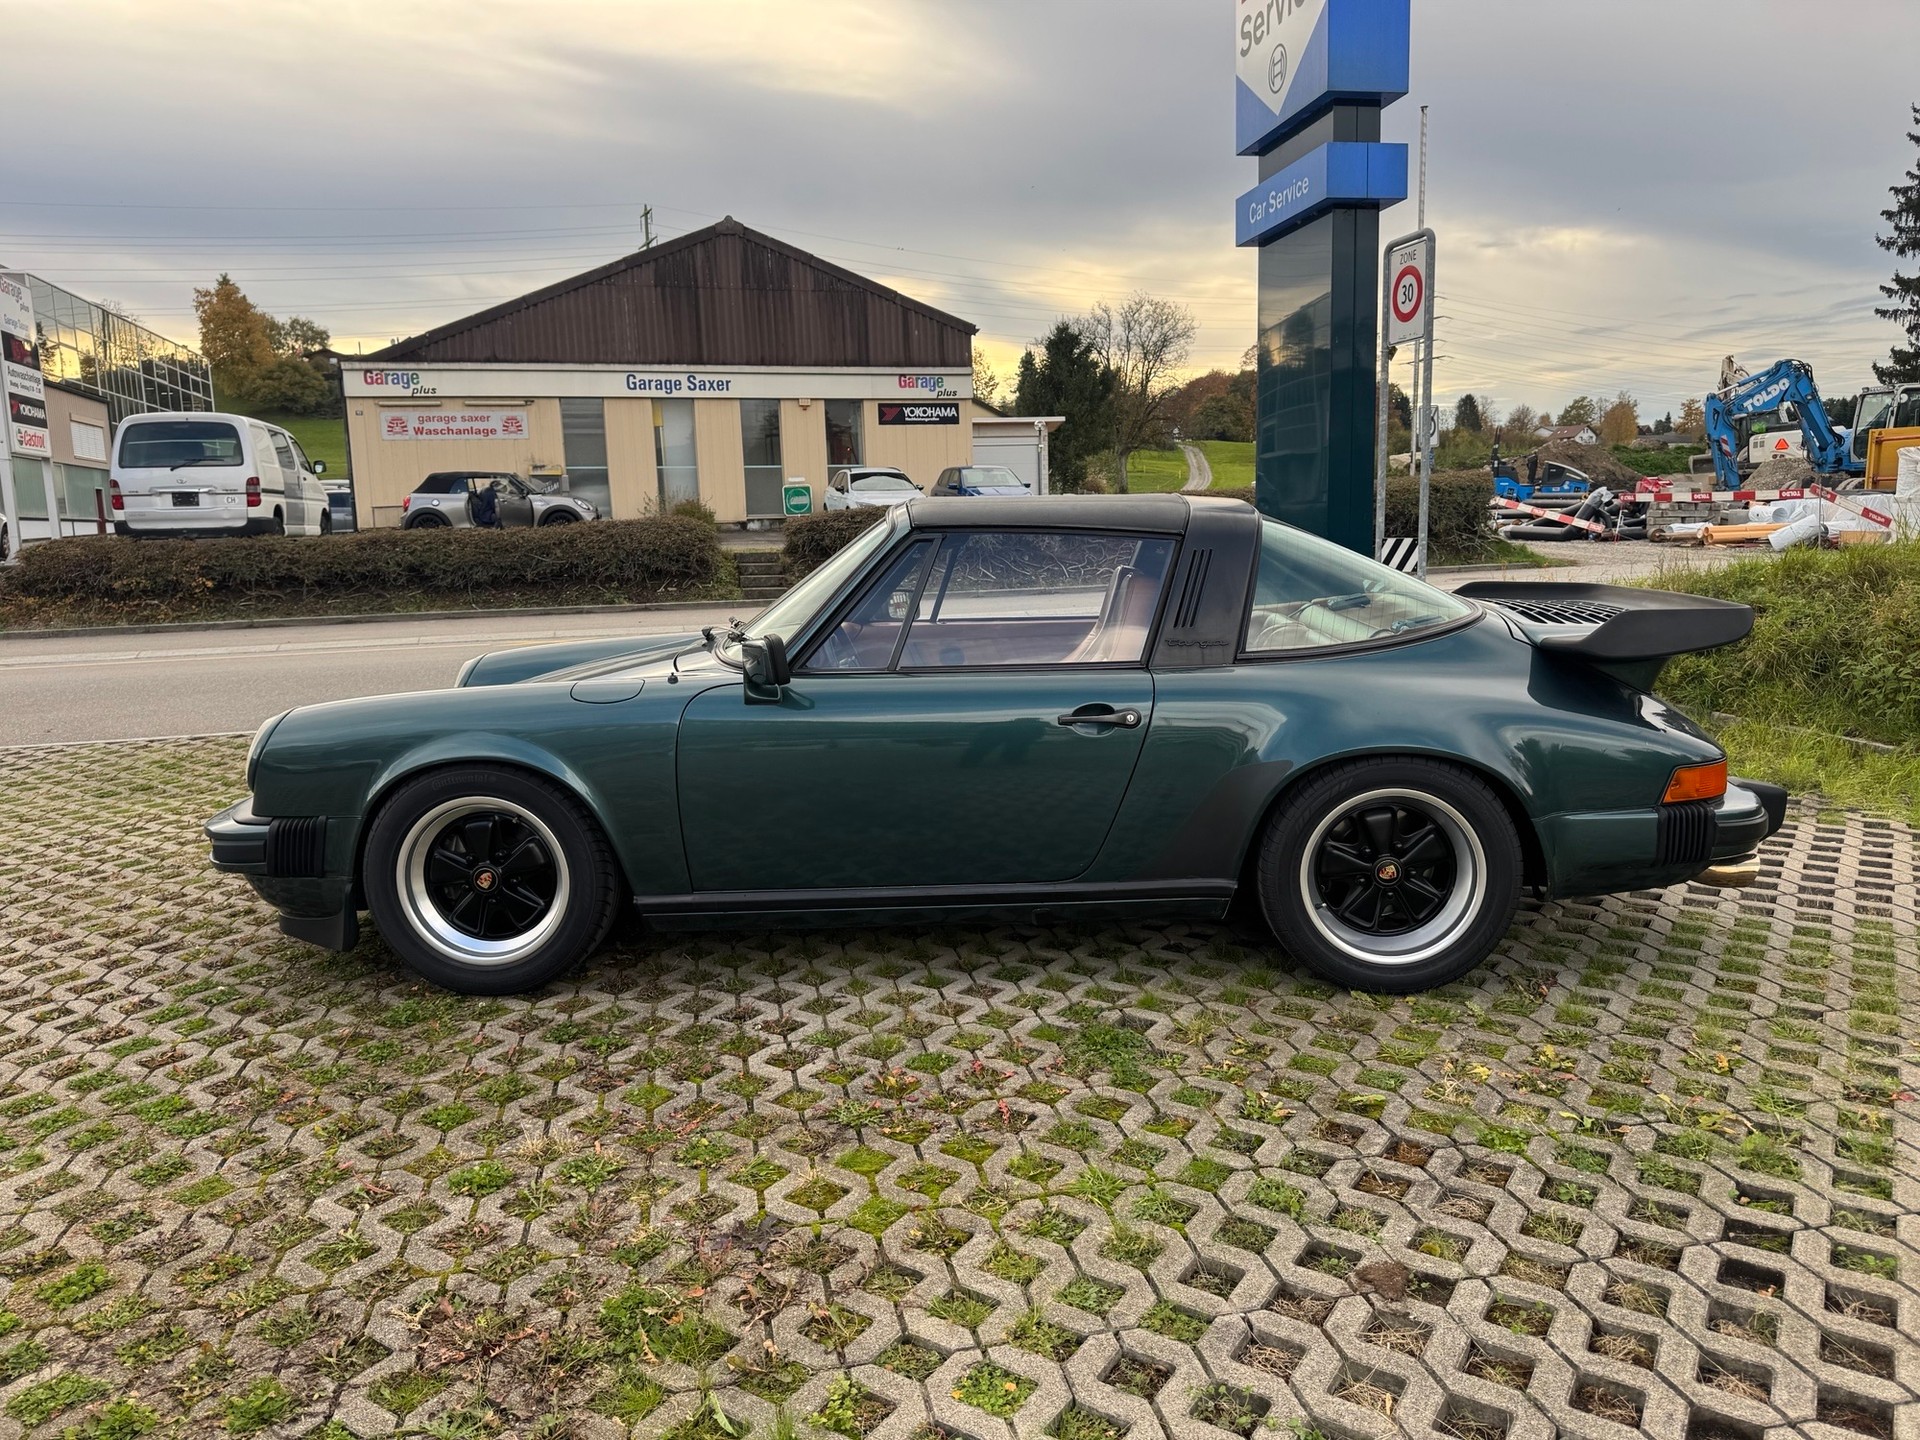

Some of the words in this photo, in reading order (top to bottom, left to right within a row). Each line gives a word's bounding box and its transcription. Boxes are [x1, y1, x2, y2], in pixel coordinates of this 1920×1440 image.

[1249, 202, 1266, 224] Car
[1268, 177, 1309, 213] Service
[1399, 249, 1417, 265] ZONE
[1401, 283, 1414, 304] 30
[364, 369, 420, 389] Garage
[626, 374, 682, 395] Garage
[687, 374, 732, 391] Saxer
[898, 374, 944, 392] Garage
[411, 386, 437, 396] plus
[936, 388, 957, 398] plus
[1743, 377, 1790, 412] TOLDO
[417, 414, 457, 424] garage
[902, 406, 957, 417] YOKOHAMA
[24, 430, 45, 449] Castrol
[413, 426, 497, 437] Waschanlage
[226, 496, 236, 504] CH
